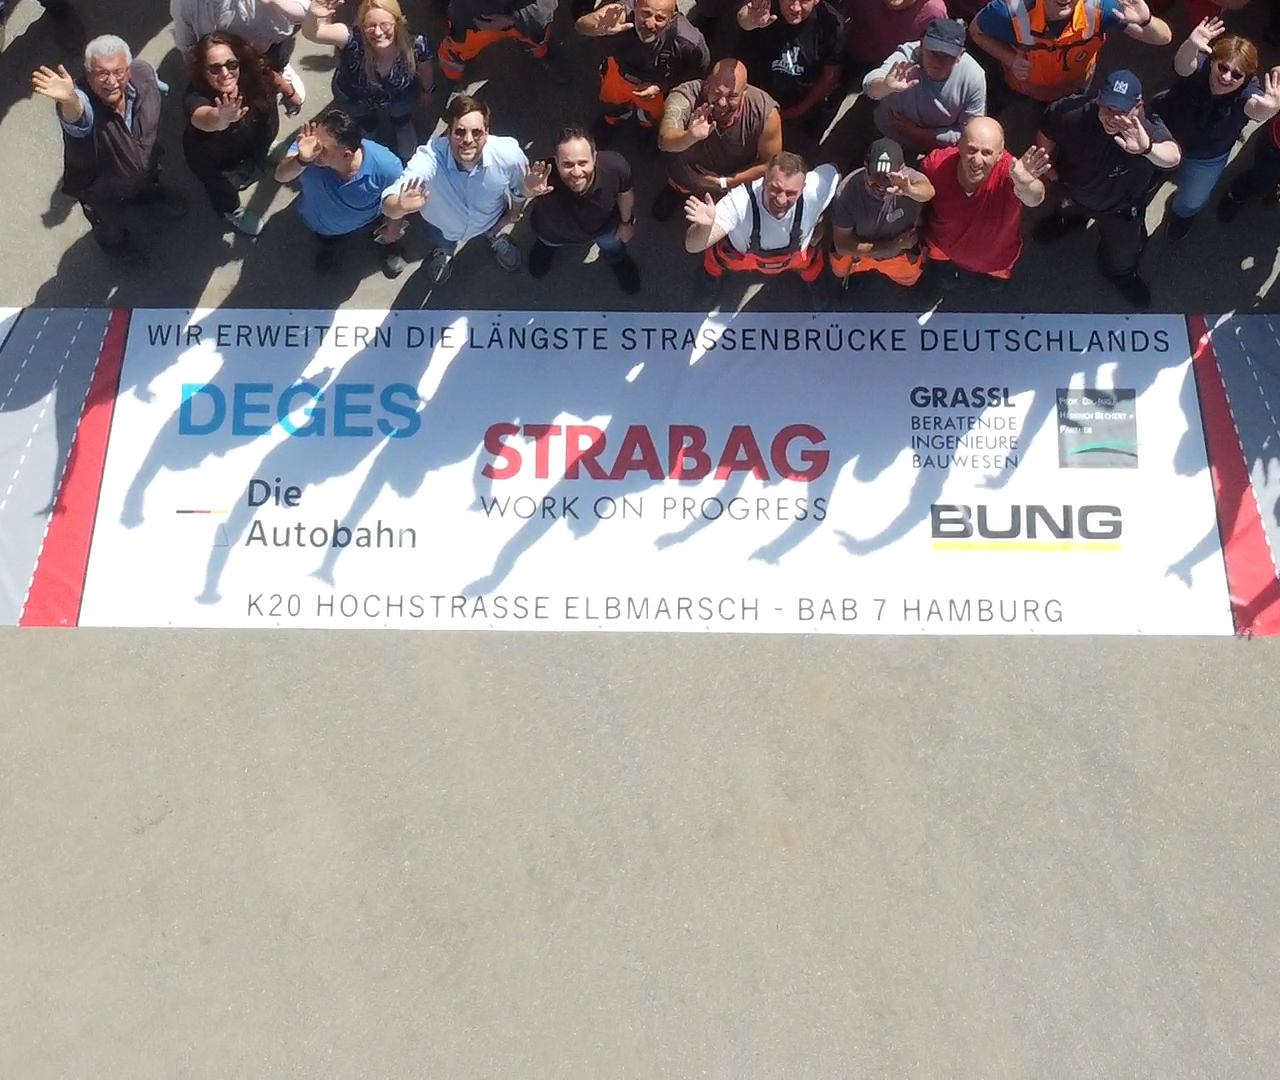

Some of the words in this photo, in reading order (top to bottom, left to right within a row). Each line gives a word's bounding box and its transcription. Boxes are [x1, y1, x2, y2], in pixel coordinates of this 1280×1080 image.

[148, 325, 201, 348] WIR
[216, 325, 394, 349] ERWEITERN
[406, 326, 455, 349] DIE
[468, 320, 610, 351] LÄNGSTE
[621, 324, 907, 352] STRASSENBRÜCKE
[921, 327, 1170, 353] DEUTSCHLANDS
[178, 383, 422, 439] DEGES
[910, 387, 1016, 408] GRASSL
[911, 415, 1018, 431] BERATENDE
[482, 424, 830, 481] STRABAG
[911, 435, 1018, 451] INGENIEURE
[911, 454, 1019, 469] BAUWESEN
[247, 479, 303, 510] Die
[481, 495, 580, 521] WORK
[594, 496, 643, 521] ON
[664, 496, 826, 522] PROGRESS
[246, 520, 417, 549] Autobahn
[931, 504, 1121, 540] BUNG
[247, 594, 303, 619] K20
[316, 594, 549, 620] HOCHSTRASSE
[565, 596, 760, 622] ELBMARSCH
[797, 598, 859, 622] BAB
[874, 598, 888, 623] 7
[903, 598, 1063, 623] HAMBURG
